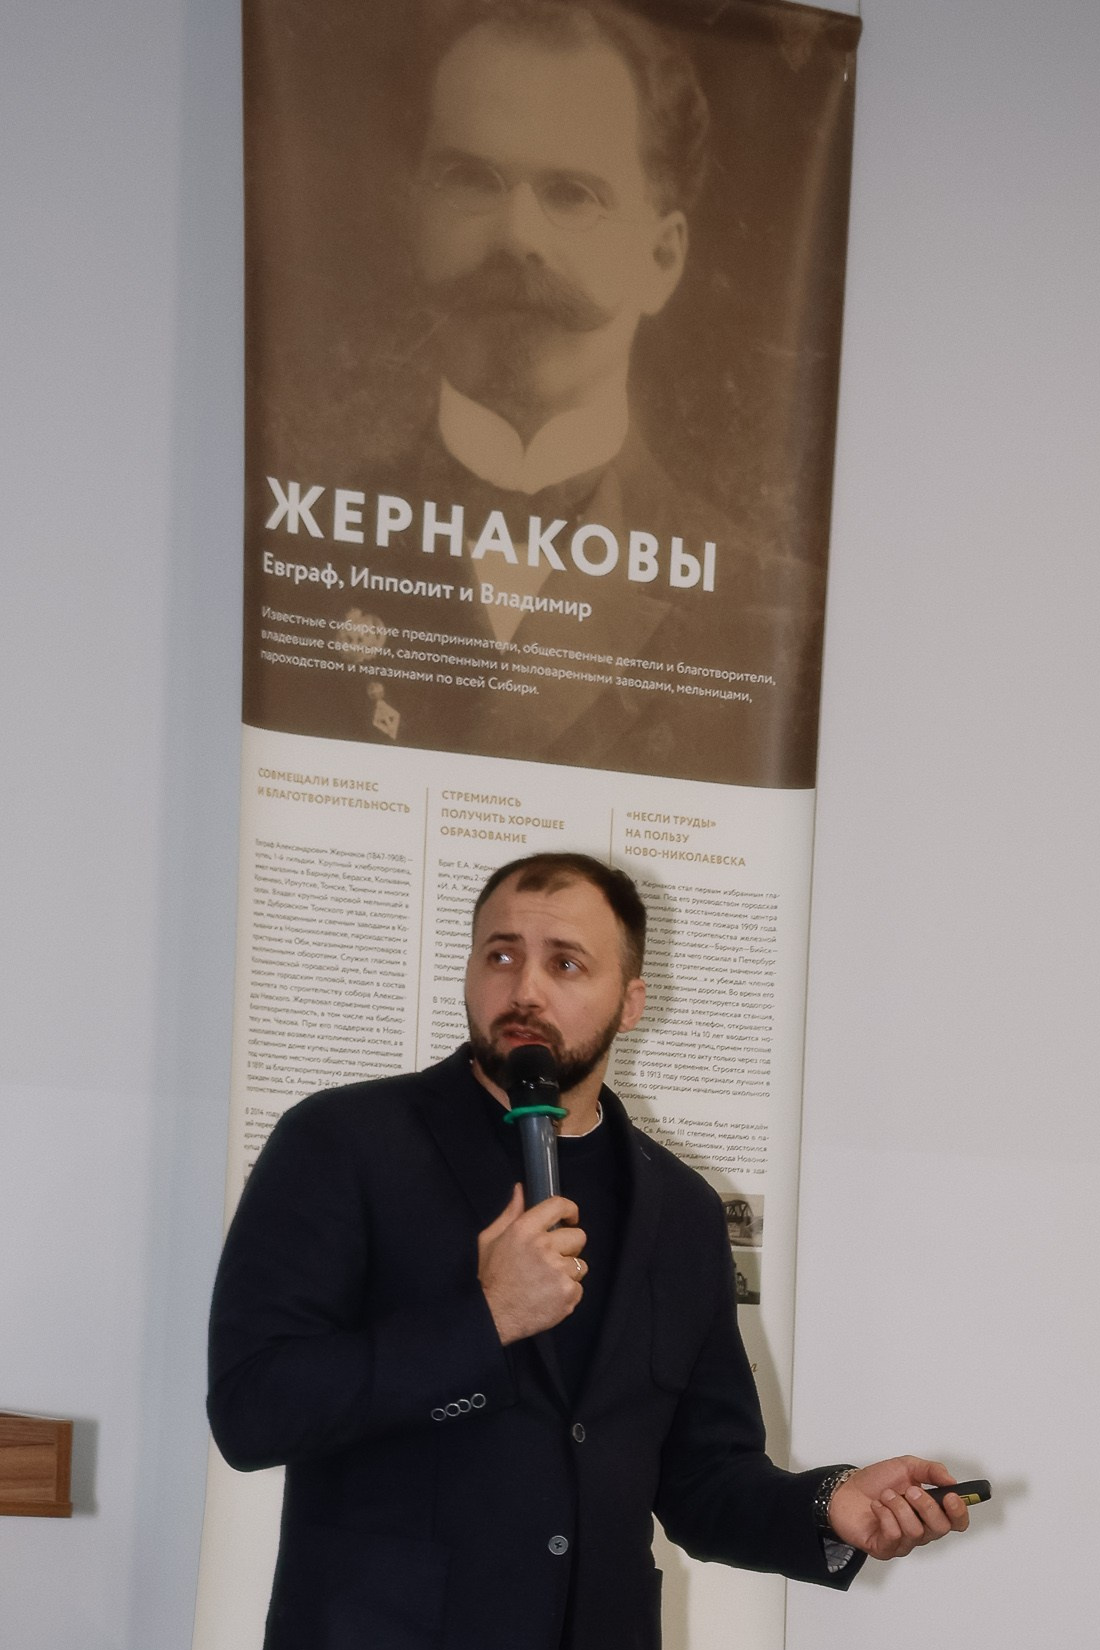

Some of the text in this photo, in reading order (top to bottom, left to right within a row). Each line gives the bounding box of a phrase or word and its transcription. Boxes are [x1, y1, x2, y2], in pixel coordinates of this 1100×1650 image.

[265, 475, 718, 593] ЖЕРНАКОВЫ
[263, 553, 593, 620] Евграф, Ипполит и Владимир
[261, 606, 777, 686] Известные сибирские предприниматели, общественные деятели и благотворители,
[261, 630, 753, 703] владевшие свечными, салотопенными и мыловаренными заводами, мельницами,
[261, 652, 540, 696] пароходством и магазинами по всей Сибири.
[258, 767, 379, 792] СОВМЕЩАЛИ БИЗНЕС
[258, 786, 411, 814] И БЛАГОТВОРИТЕЛЬНОСТЬ
[442, 789, 522, 808] СТРЕМИЛИСЬ
[441, 807, 566, 830] ПОЛУЧИТЬ ХОРОШЕЕ
[627, 811, 717, 829] «НЕСЛИ ТРУДЫ»
[440, 825, 528, 844] ОБРАЗОВАНИЕ
[626, 828, 690, 843] НА ПОЛЬЗУ
[625, 845, 746, 867] НОВО-НИКОЛАЕВСКА
